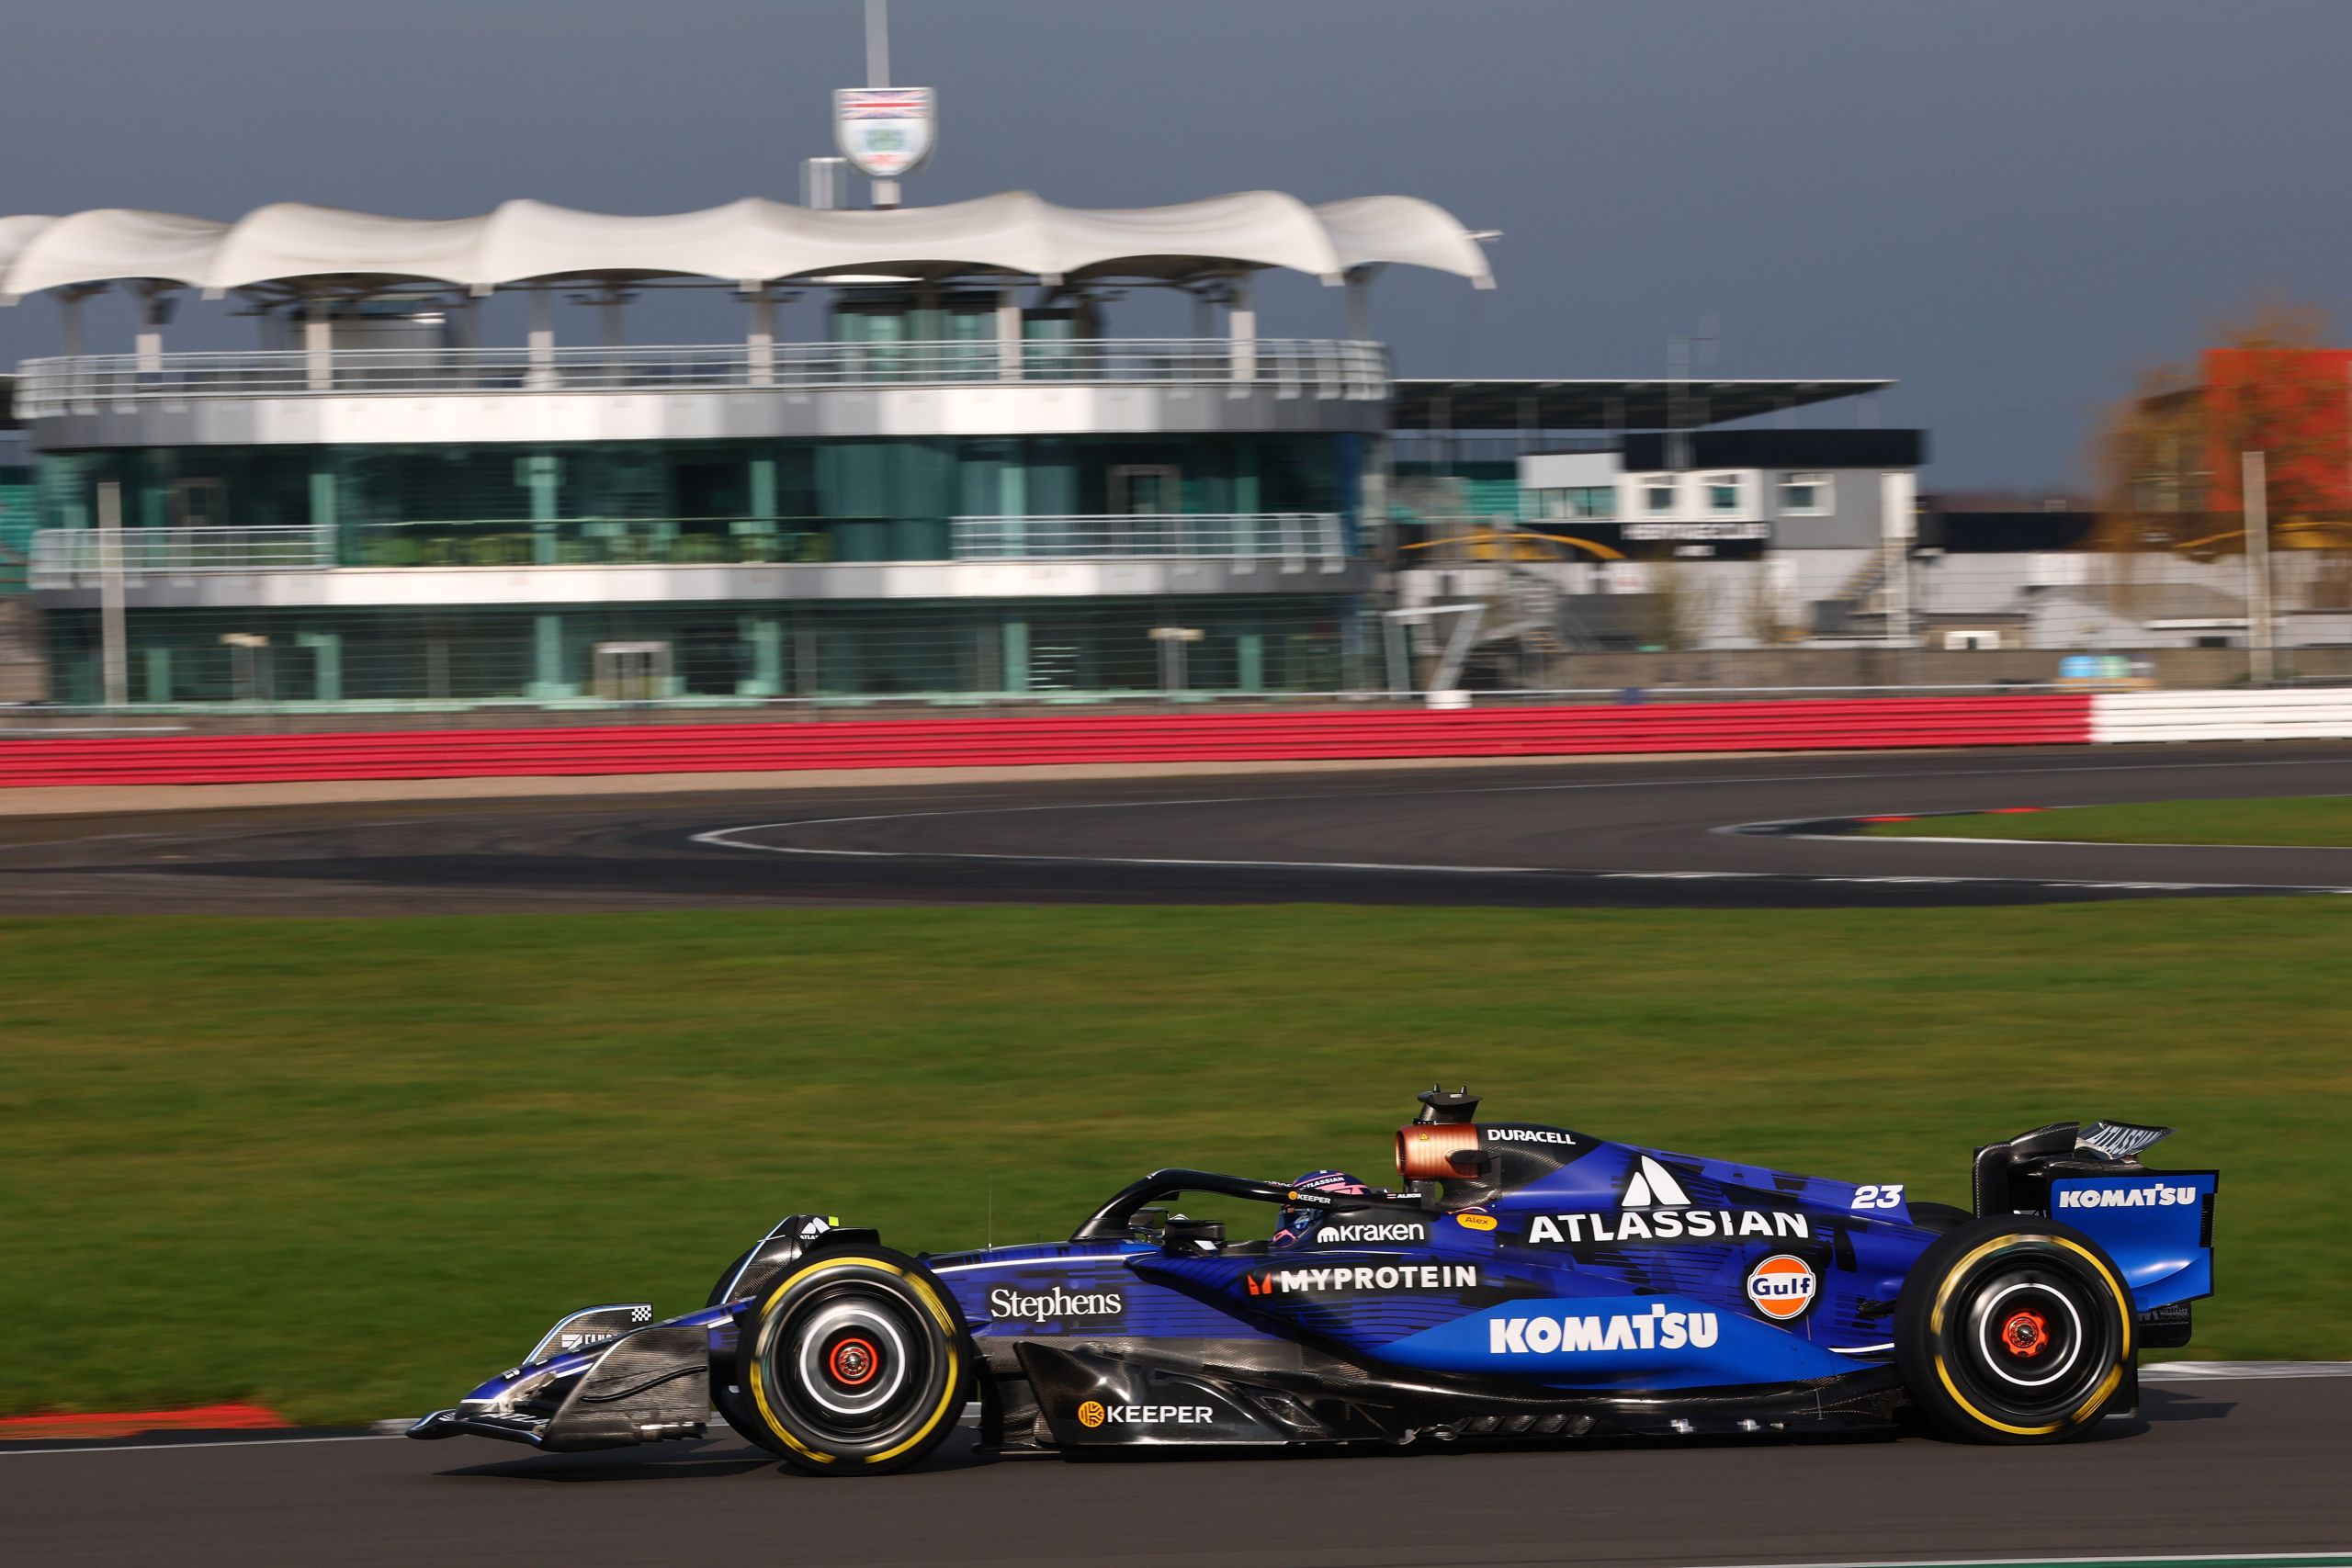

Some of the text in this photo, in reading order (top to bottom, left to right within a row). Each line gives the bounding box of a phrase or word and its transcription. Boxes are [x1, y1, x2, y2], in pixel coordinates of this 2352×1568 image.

[1487, 1129, 1576, 1145] DURACELL
[1297, 1194, 1331, 1204] KEEPER
[1851, 1185, 1904, 1210] 23
[2059, 1183, 2196, 1208] KOMATSU
[1464, 1216, 1489, 1225] Alex
[1529, 1211, 1809, 1244] ATLASSIAN
[1281, 1266, 1477, 1293] MYPROTEIN
[1752, 1278, 1811, 1296] Gulf
[990, 1286, 1122, 1323] Stephens
[1489, 1303, 1719, 1354] KOMATSU
[1107, 1405, 1214, 1424] KEEPER
